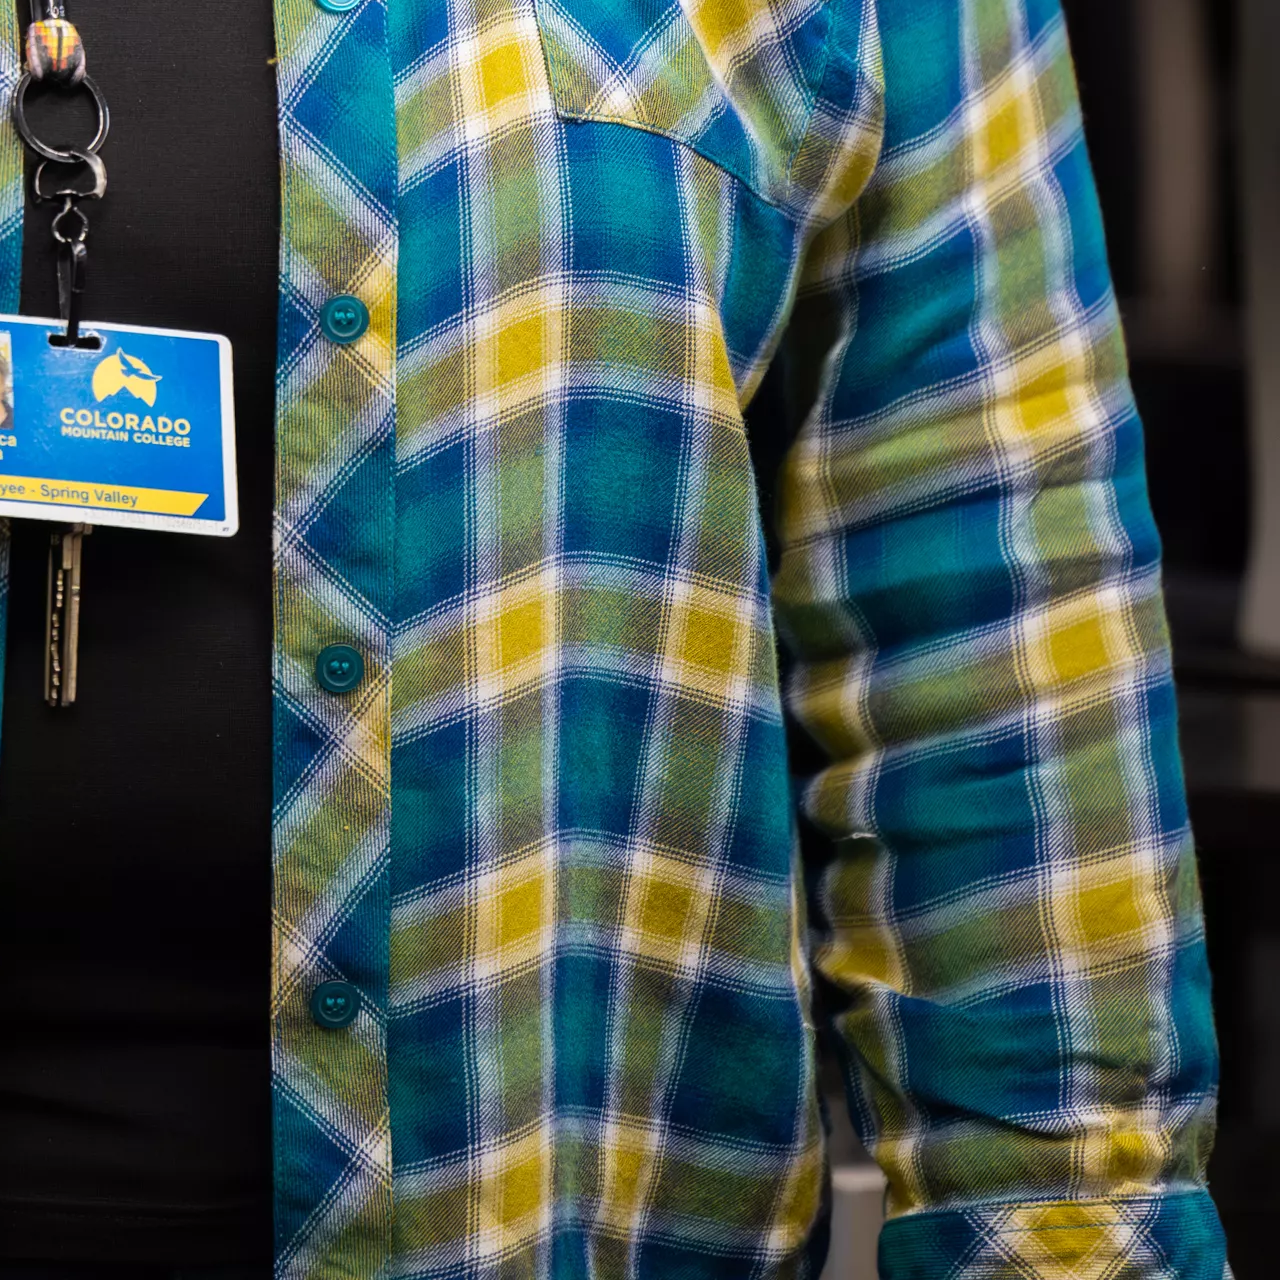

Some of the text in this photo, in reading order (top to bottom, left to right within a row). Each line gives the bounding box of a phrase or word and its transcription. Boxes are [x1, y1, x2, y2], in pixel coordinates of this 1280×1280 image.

[59, 407, 192, 436] COLORADO
[61, 426, 191, 448] MOUNTAIN COLLEGE
[40, 484, 90, 502] Spring
[93, 488, 139, 507] Valley
